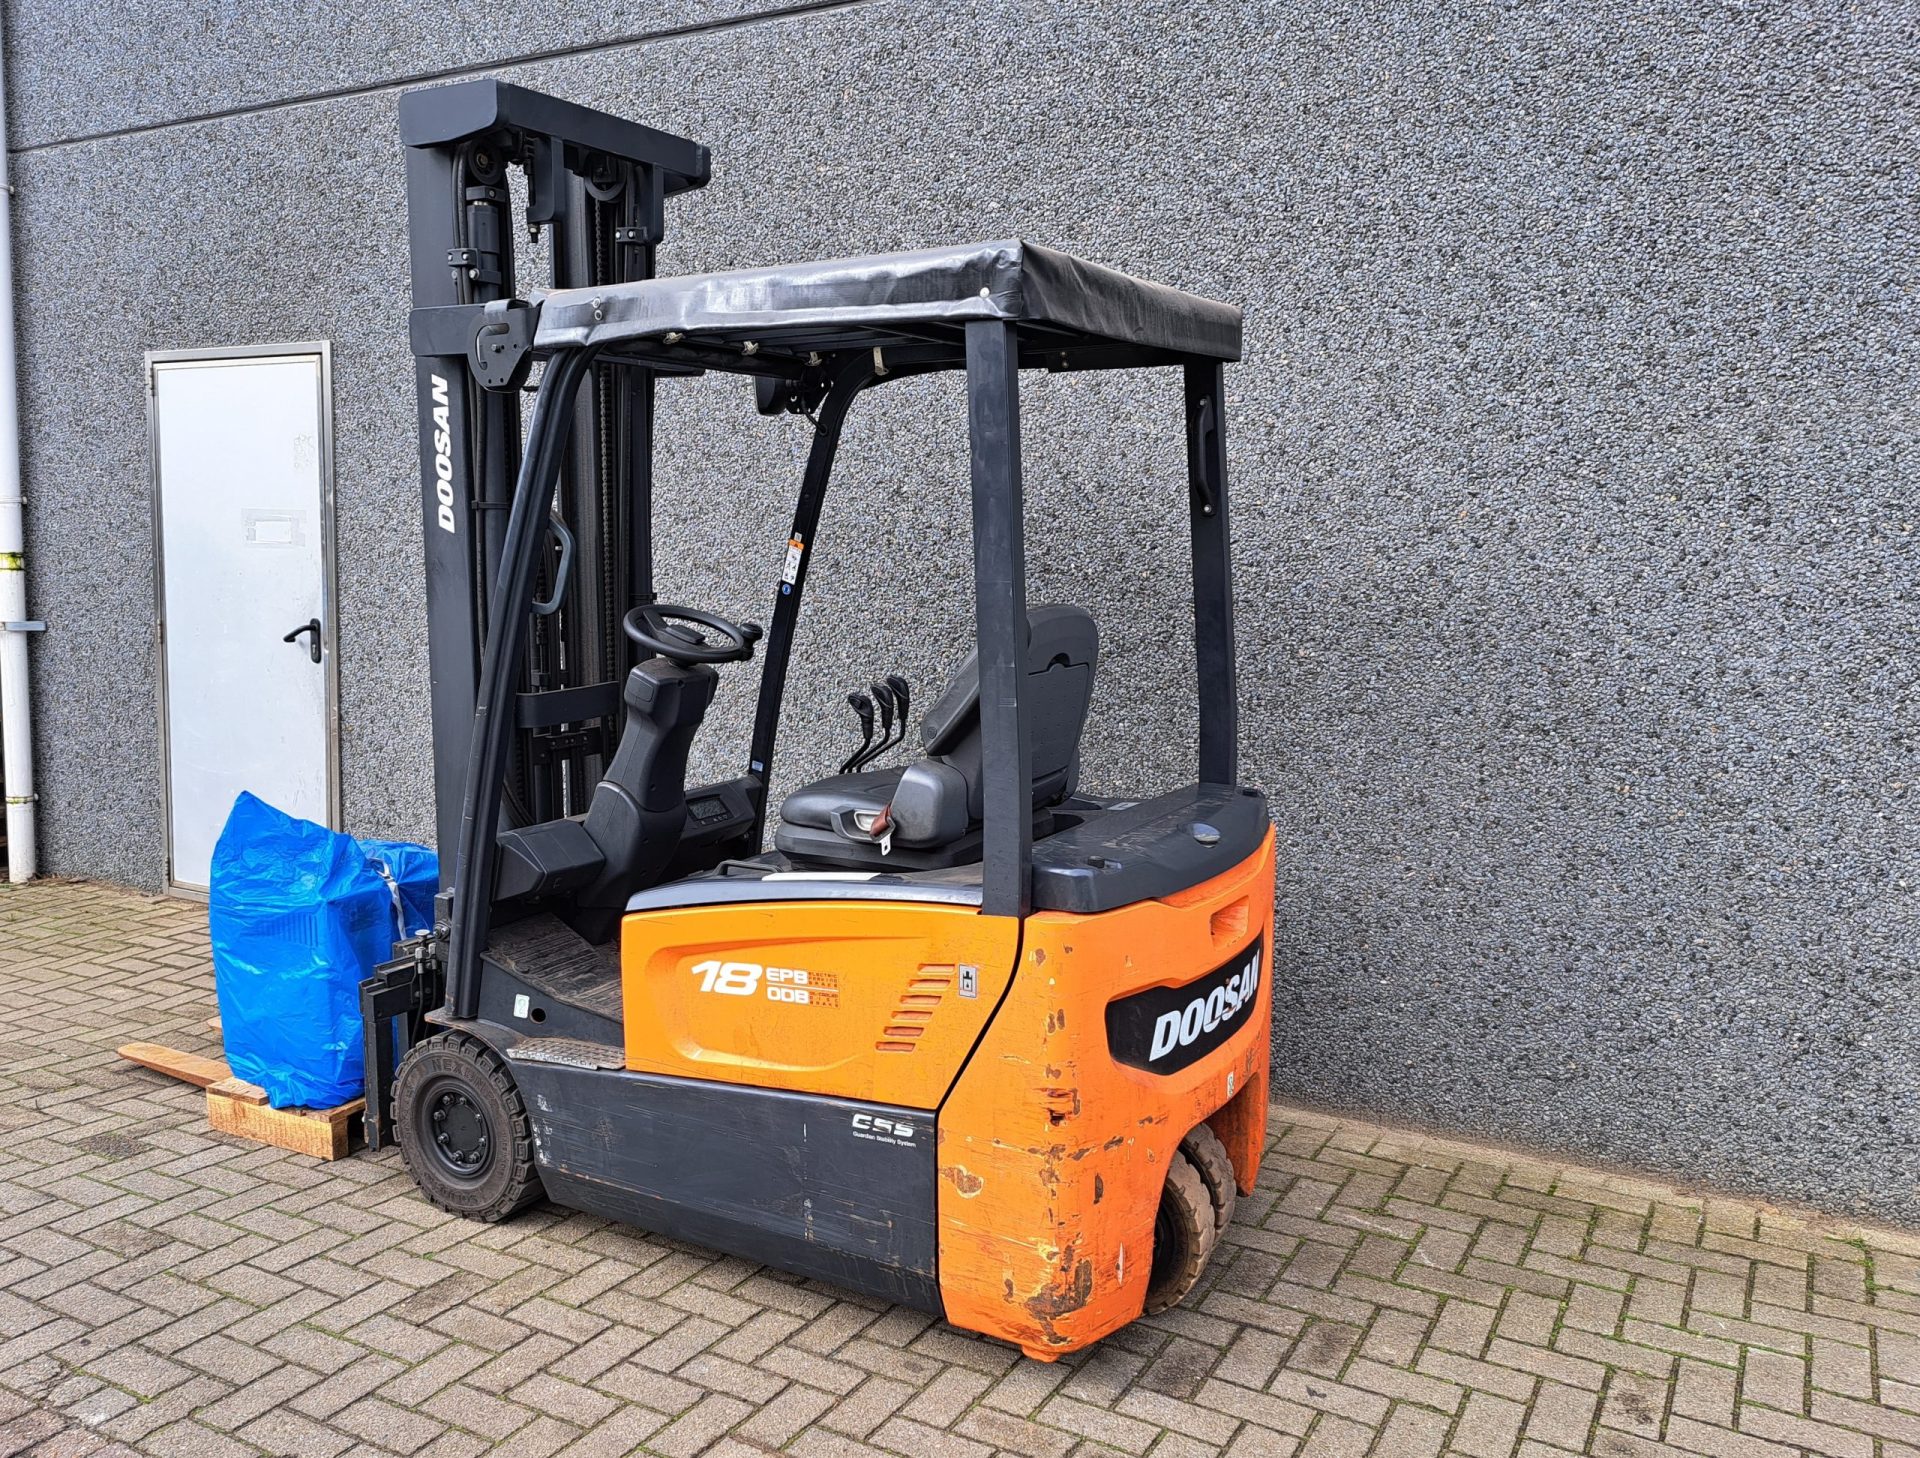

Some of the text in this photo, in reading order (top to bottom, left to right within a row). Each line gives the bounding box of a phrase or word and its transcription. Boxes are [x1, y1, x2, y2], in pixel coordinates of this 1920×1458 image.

[431, 374, 455, 534] DOOSAN
[691, 960, 763, 996] 18
[765, 967, 808, 985] EPB
[1149, 949, 1260, 1062] DOOSAN
[876, 1135, 897, 1144] Stability
[896, 1139, 917, 1148] System
